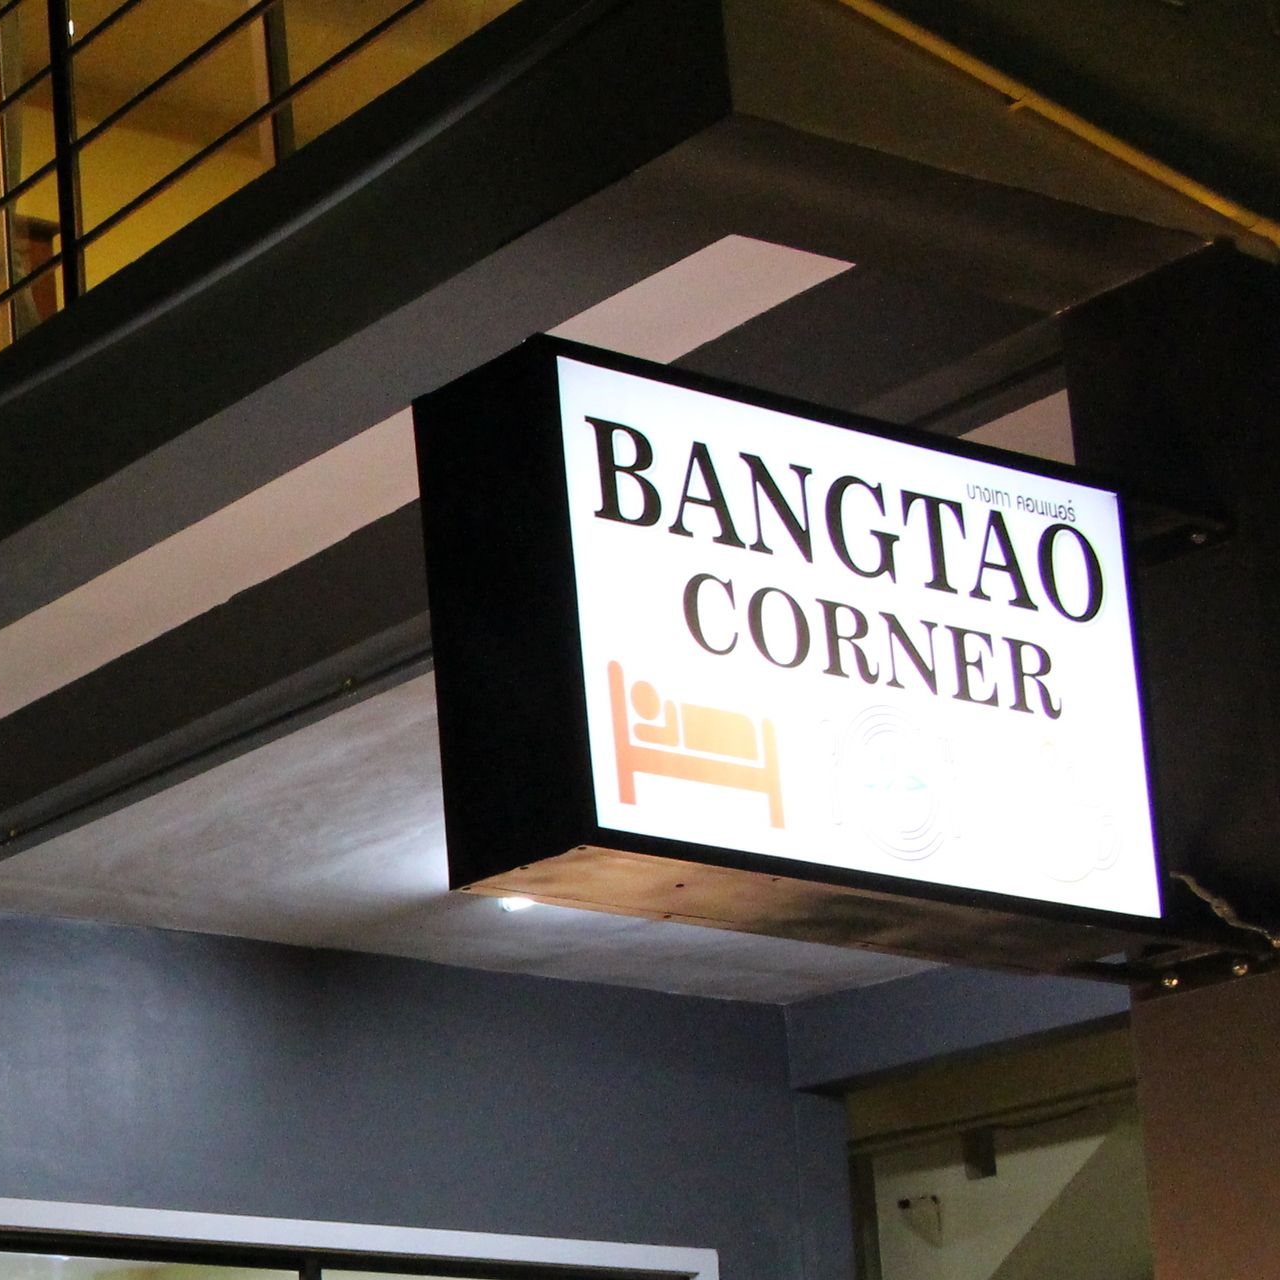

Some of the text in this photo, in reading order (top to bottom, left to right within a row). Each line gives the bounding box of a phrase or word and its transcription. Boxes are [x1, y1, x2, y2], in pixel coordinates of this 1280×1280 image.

[583, 415, 1104, 624] BANGTAO
[965, 482, 1077, 523] บางเทา คอนเนอร์
[682, 571, 1063, 720] CORNER
